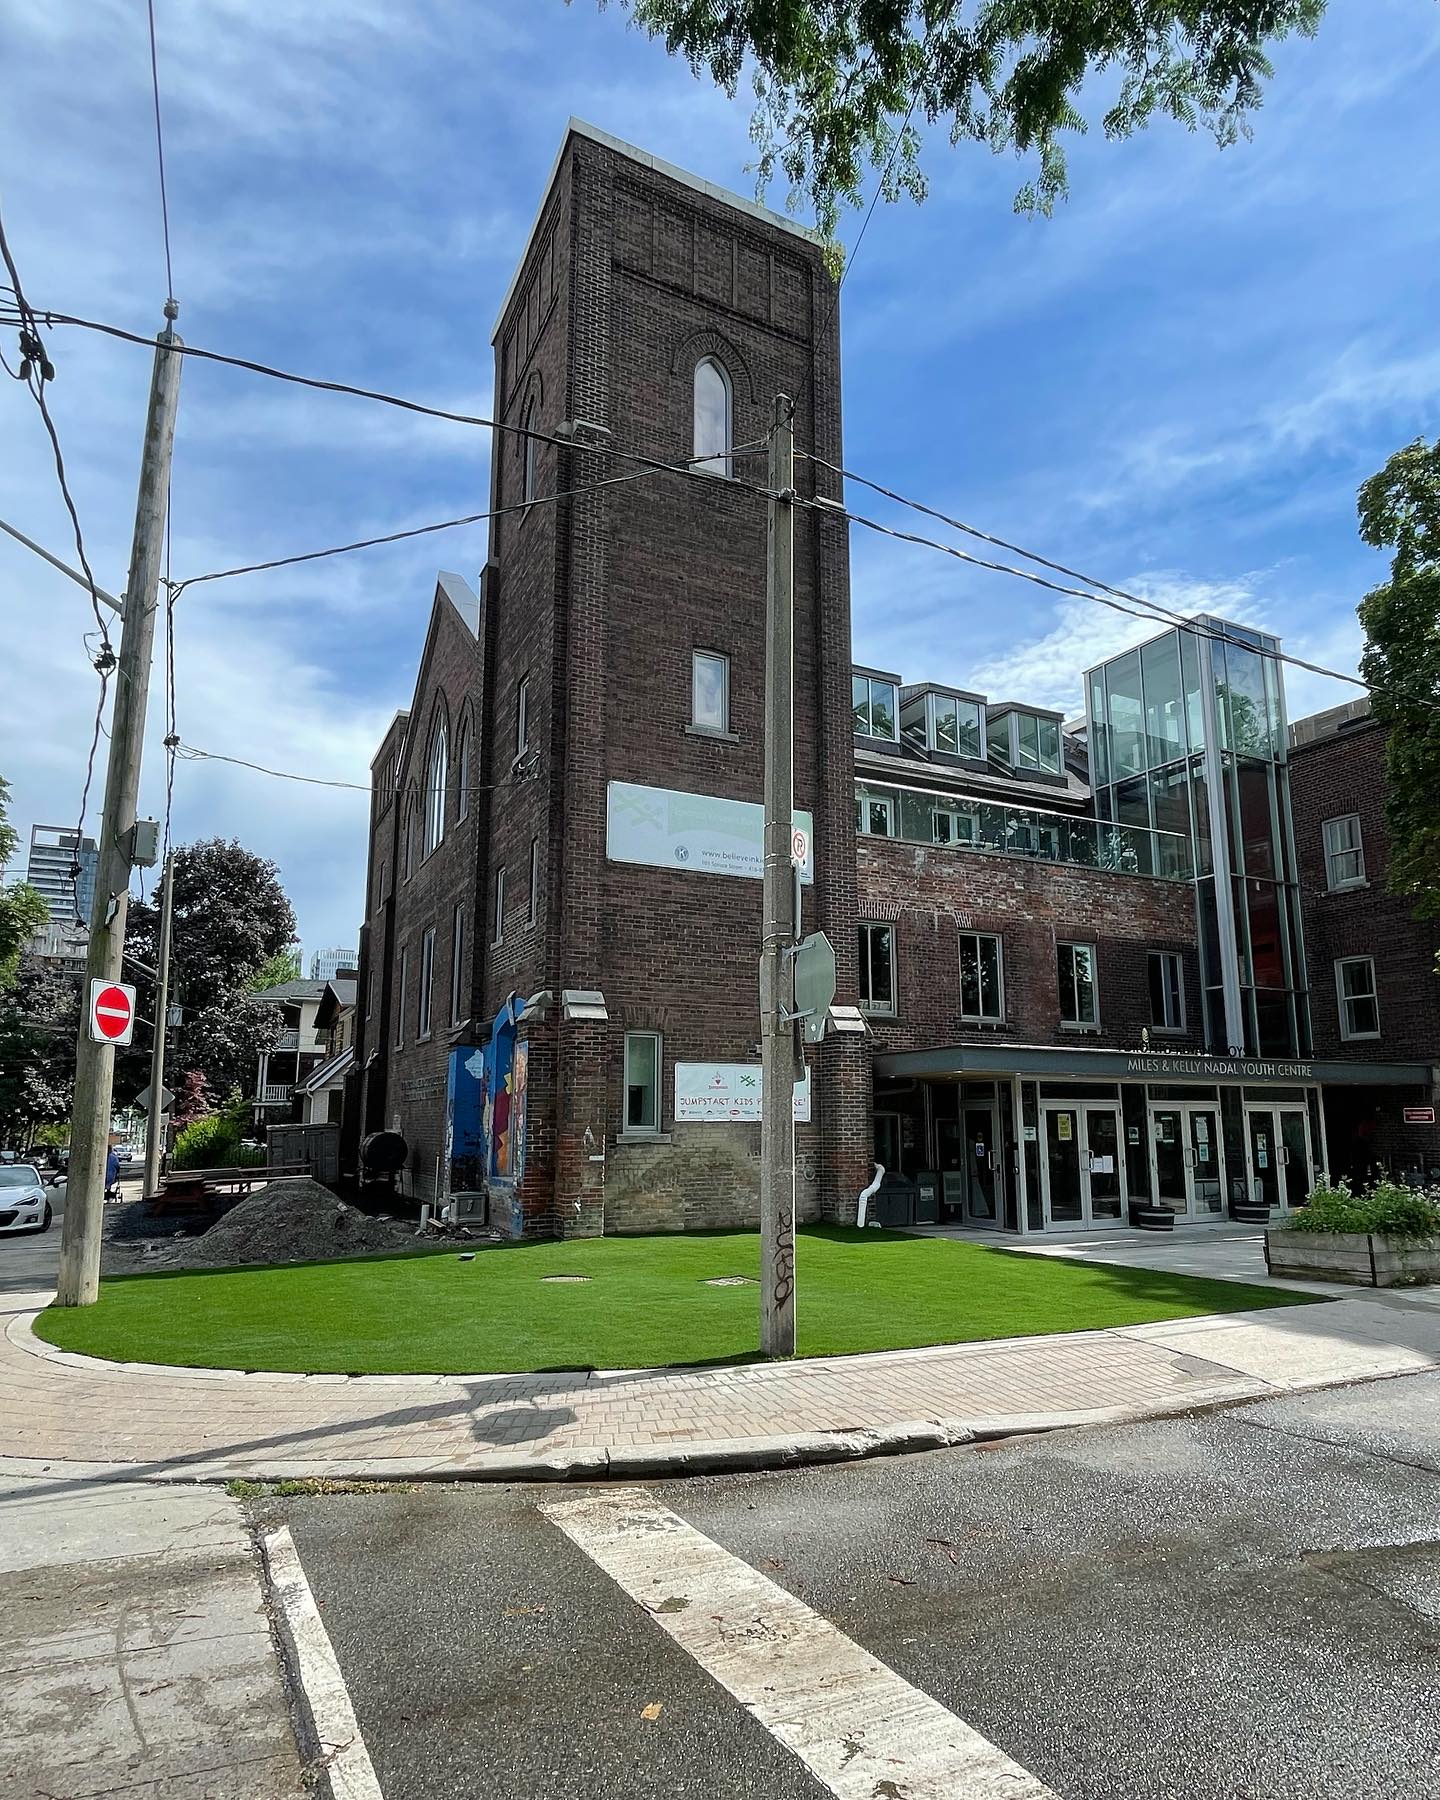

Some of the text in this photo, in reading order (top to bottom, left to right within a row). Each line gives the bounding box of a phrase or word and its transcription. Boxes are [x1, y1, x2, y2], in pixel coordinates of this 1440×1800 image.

[1127, 1058, 1312, 1077] MILES & KELLY NADAL YOUTH CENTRE
[680, 1097, 730, 1106] JUMPSTART
[733, 1097, 753, 1106] KIDS
